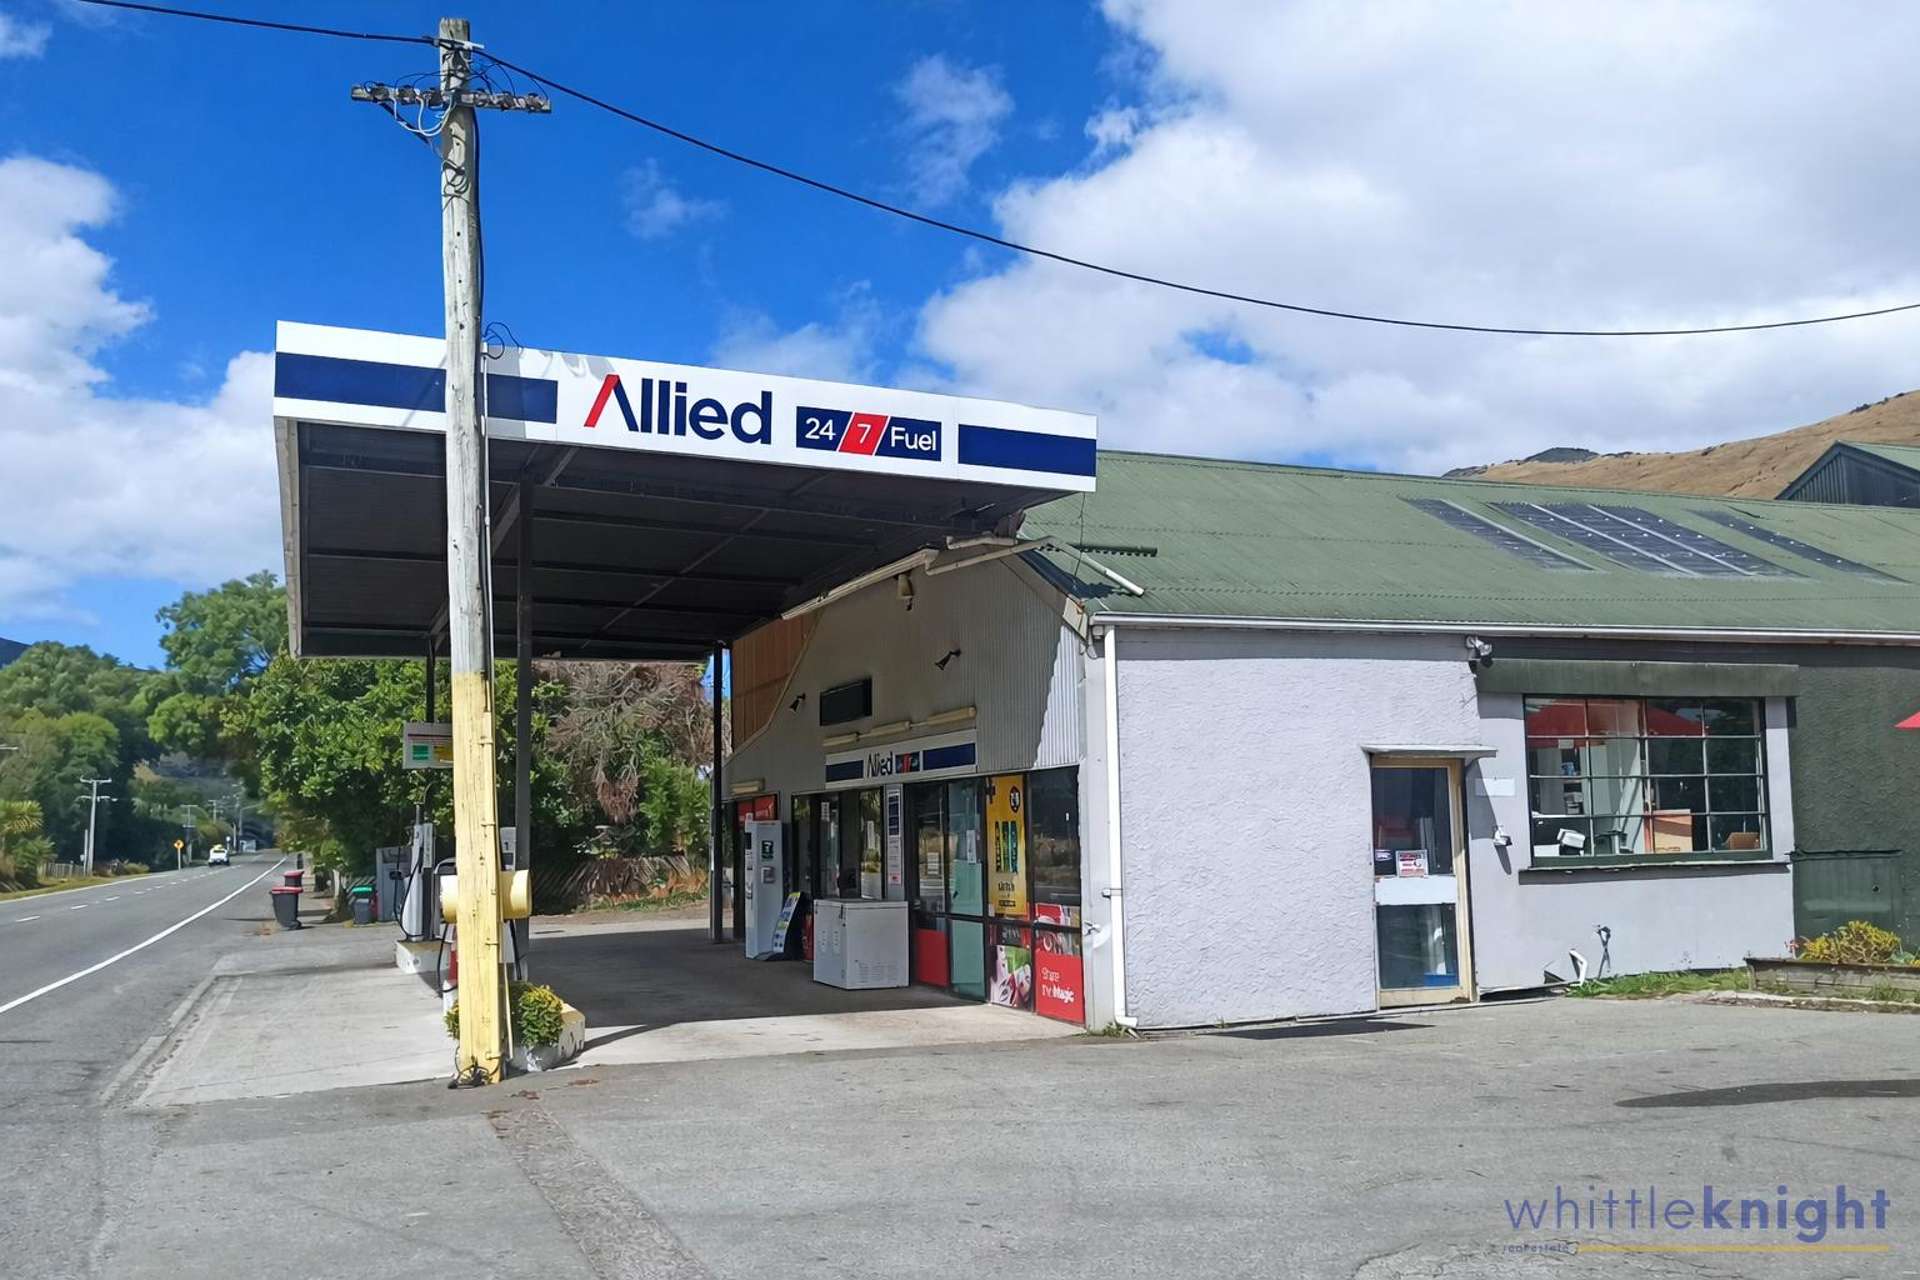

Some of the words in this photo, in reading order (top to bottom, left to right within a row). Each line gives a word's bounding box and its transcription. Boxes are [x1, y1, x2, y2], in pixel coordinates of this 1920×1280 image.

[584, 374, 772, 444] Allied
[805, 418, 837, 441] 24
[891, 427, 936, 451] Fuel
